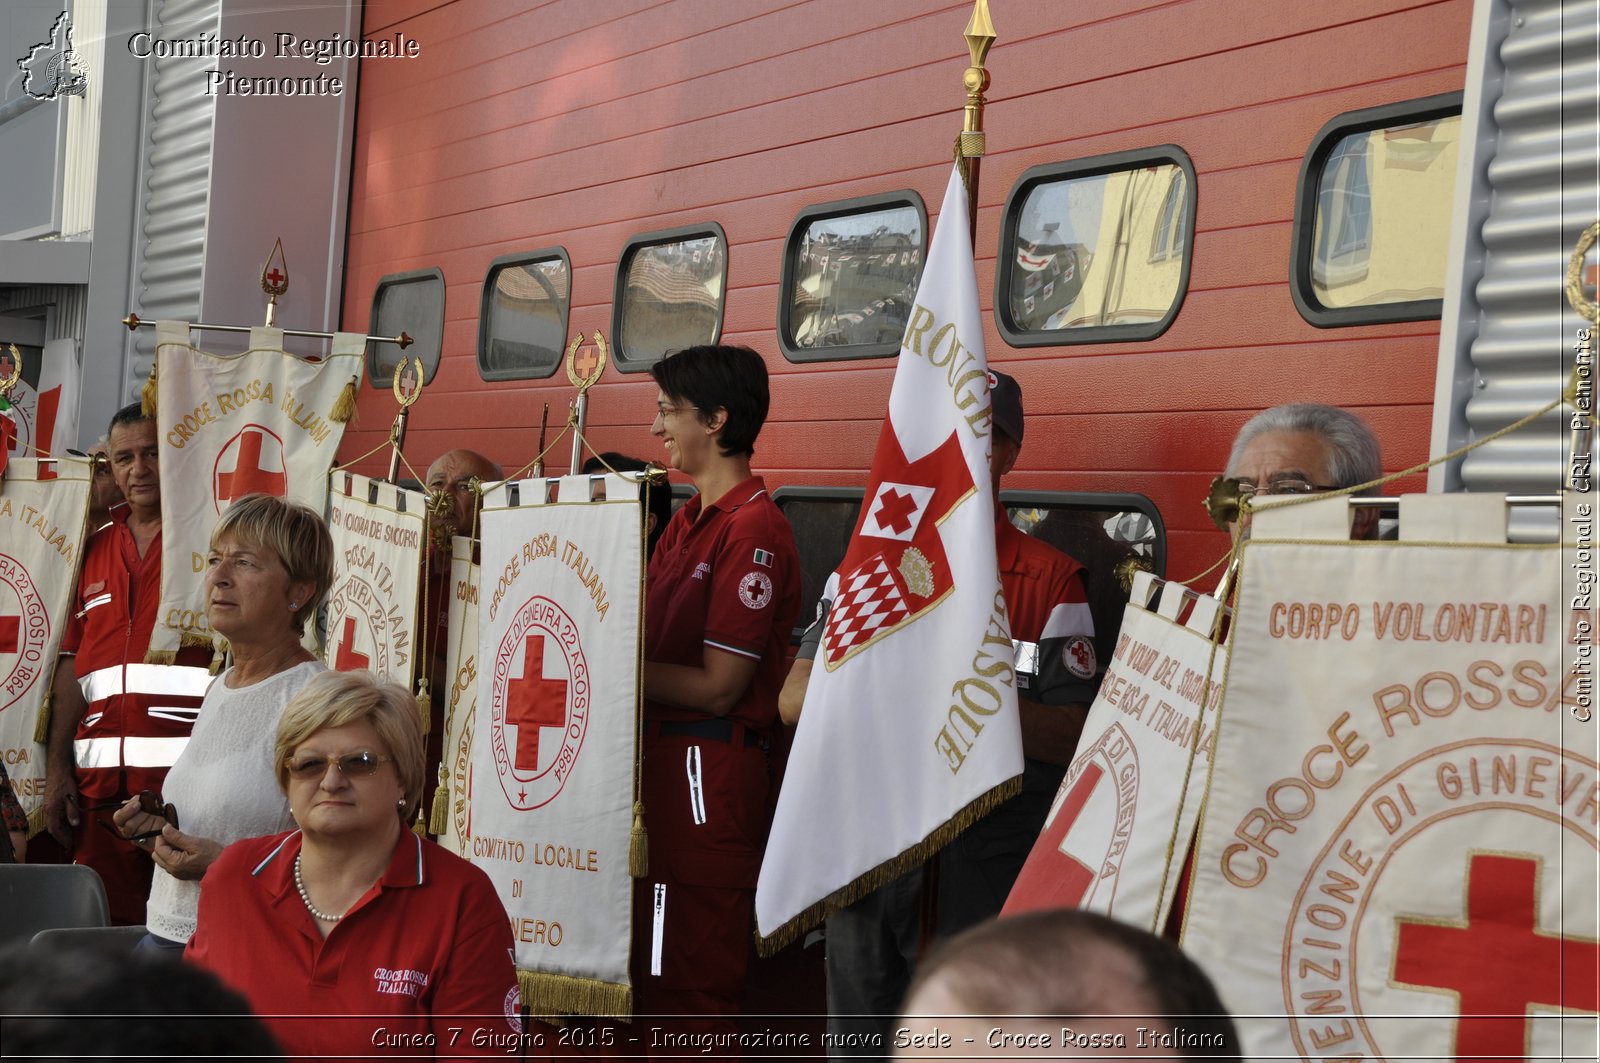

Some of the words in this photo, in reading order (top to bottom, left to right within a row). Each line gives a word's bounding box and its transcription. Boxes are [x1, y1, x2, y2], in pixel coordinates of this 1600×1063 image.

[902, 304, 993, 439] ROUGE
[166, 402, 216, 449] CROCE
[217, 379, 273, 415] ROSSA
[20, 504, 74, 568] ITALIAN
[15, 573, 29, 593] 22
[489, 554, 521, 622] CROCE
[523, 533, 558, 566] ROSSA
[561, 539, 609, 623] ITALIANA
[23, 592, 45, 662] AGOSTO
[373, 561, 409, 667] ITAIANA
[513, 618, 523, 641] DI
[522, 603, 561, 633] GINEVRA
[1269, 601, 1361, 641] CORPO
[1373, 601, 1547, 644] VOLONTARI
[561, 624, 577, 651] 22
[6, 664, 34, 696] 1864
[570, 651, 588, 740] AGOSTO
[493, 635, 515, 777] CONVENZIONE
[554, 746, 575, 784] 1864
[1108, 737, 1129, 765] DI
[1220, 711, 1370, 888] CROCE
[1372, 659, 1592, 738] ROSSA
[1101, 763, 1136, 880] GINEVRA
[473, 835, 525, 863] COMITATO
[534, 843, 599, 872] LOCALE
[512, 879, 523, 898] DI
[511, 916, 563, 947] NERO
[1299, 839, 1374, 1052] ENZIONE
[1372, 781, 1417, 836] DI
[374, 967, 403, 982] CROCE
[402, 969, 428, 987] ROSSA
[377, 980, 418, 998] ITALIAN
